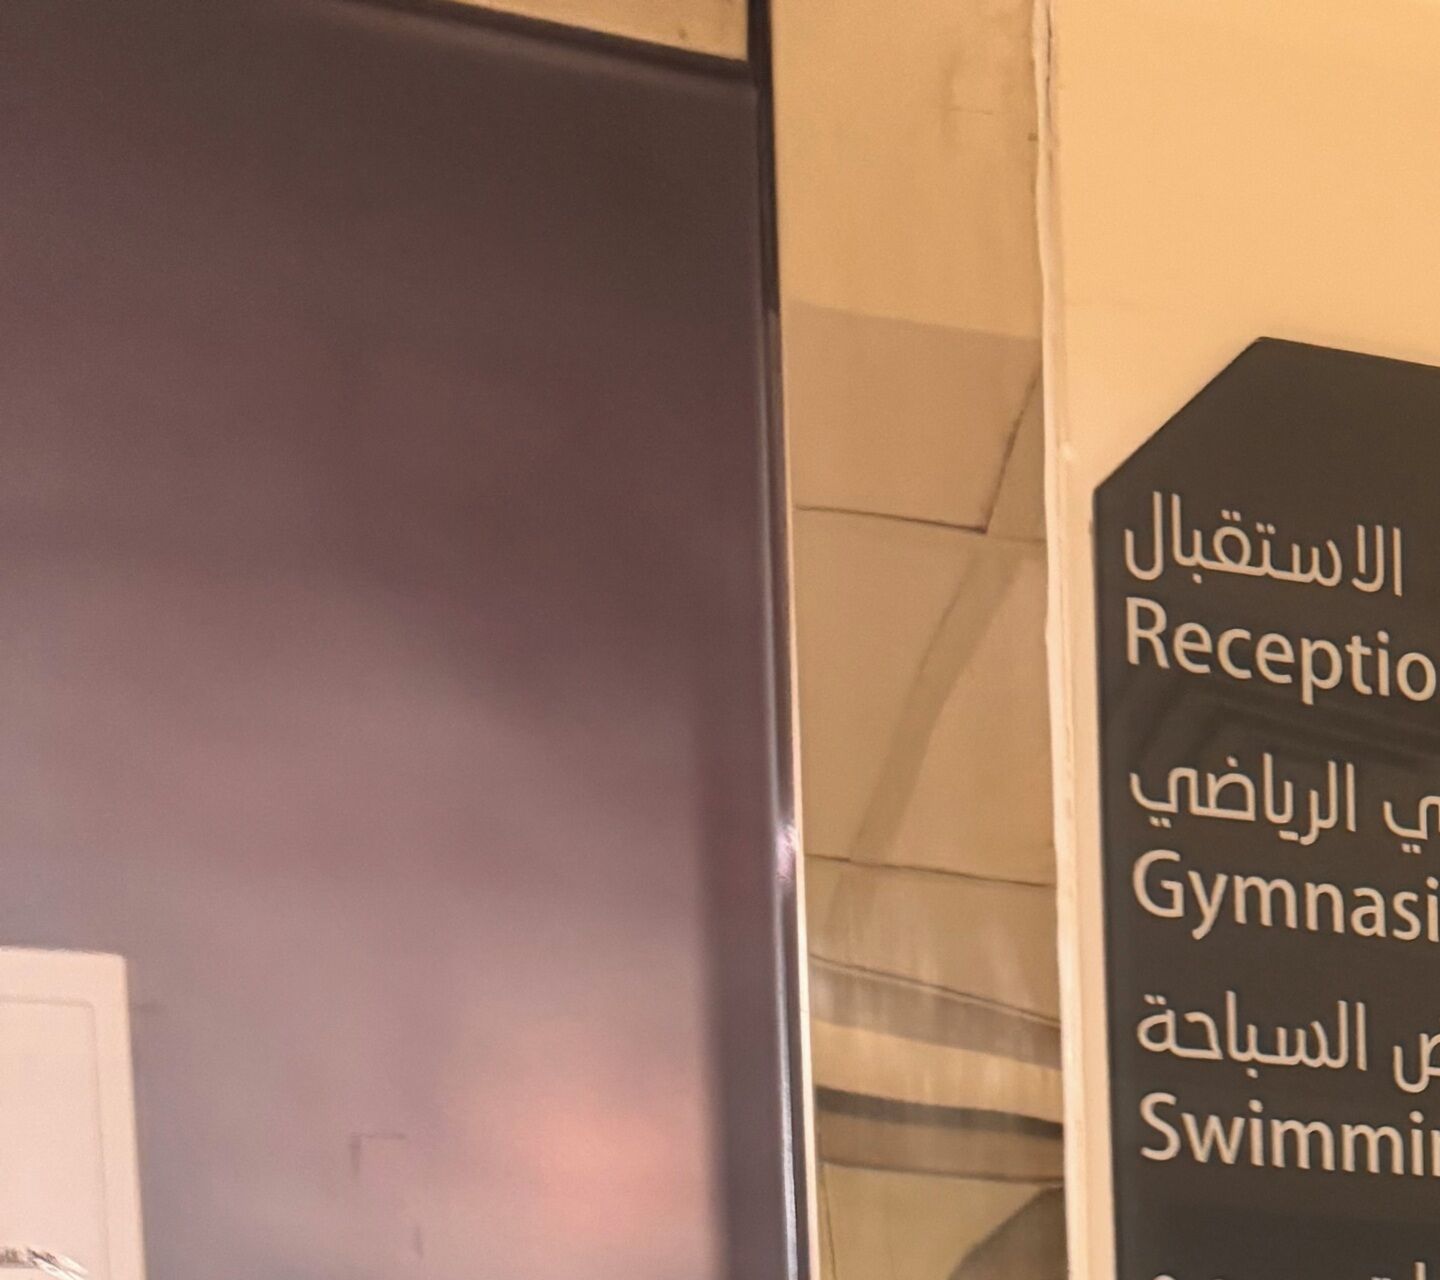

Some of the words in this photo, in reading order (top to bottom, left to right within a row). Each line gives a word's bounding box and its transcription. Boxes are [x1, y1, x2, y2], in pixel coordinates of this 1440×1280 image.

[1124, 491, 1403, 597] الاستقبال
[1130, 753, 1357, 846] الرياضي
[1137, 991, 1367, 1079] السباحة
